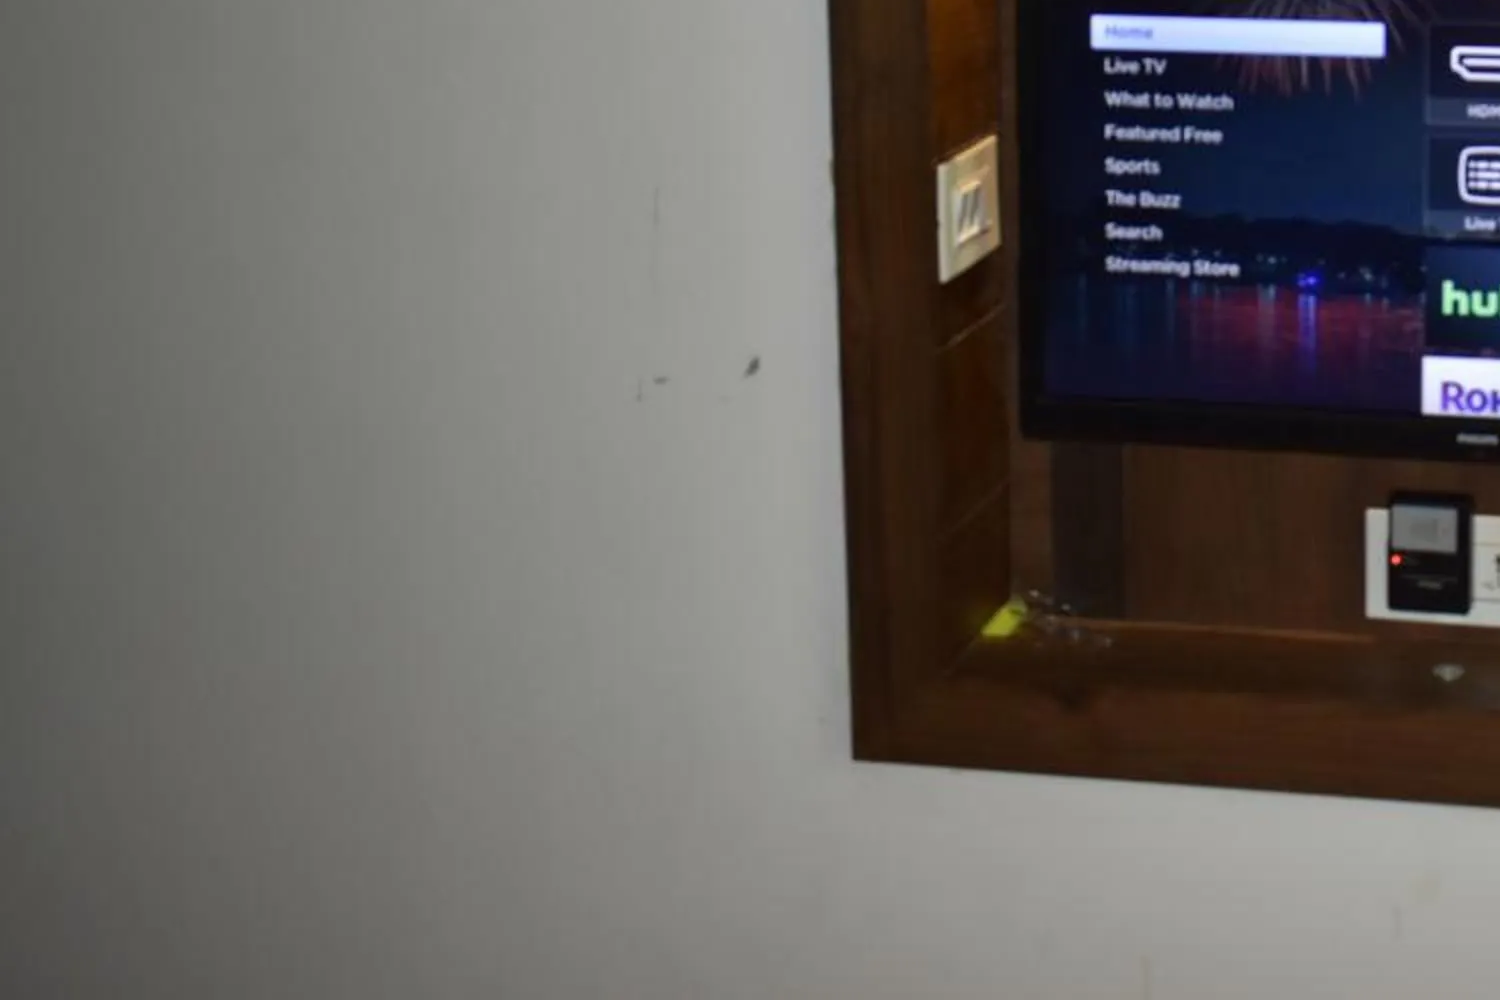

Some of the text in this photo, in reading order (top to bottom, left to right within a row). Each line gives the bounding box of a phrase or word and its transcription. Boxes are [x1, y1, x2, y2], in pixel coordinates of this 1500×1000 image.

[1104, 24, 1154, 41] Home
[1103, 57, 1167, 75] Live TV
[1104, 90, 1235, 110] What to Watch
[1104, 123, 1224, 144] Featured Free
[1104, 157, 1161, 175] Sports
[1104, 189, 1181, 209] The Buzz
[1104, 222, 1164, 241] Search
[1464, 217, 1498, 232] Live
[1104, 256, 1241, 277] Streaming Store
